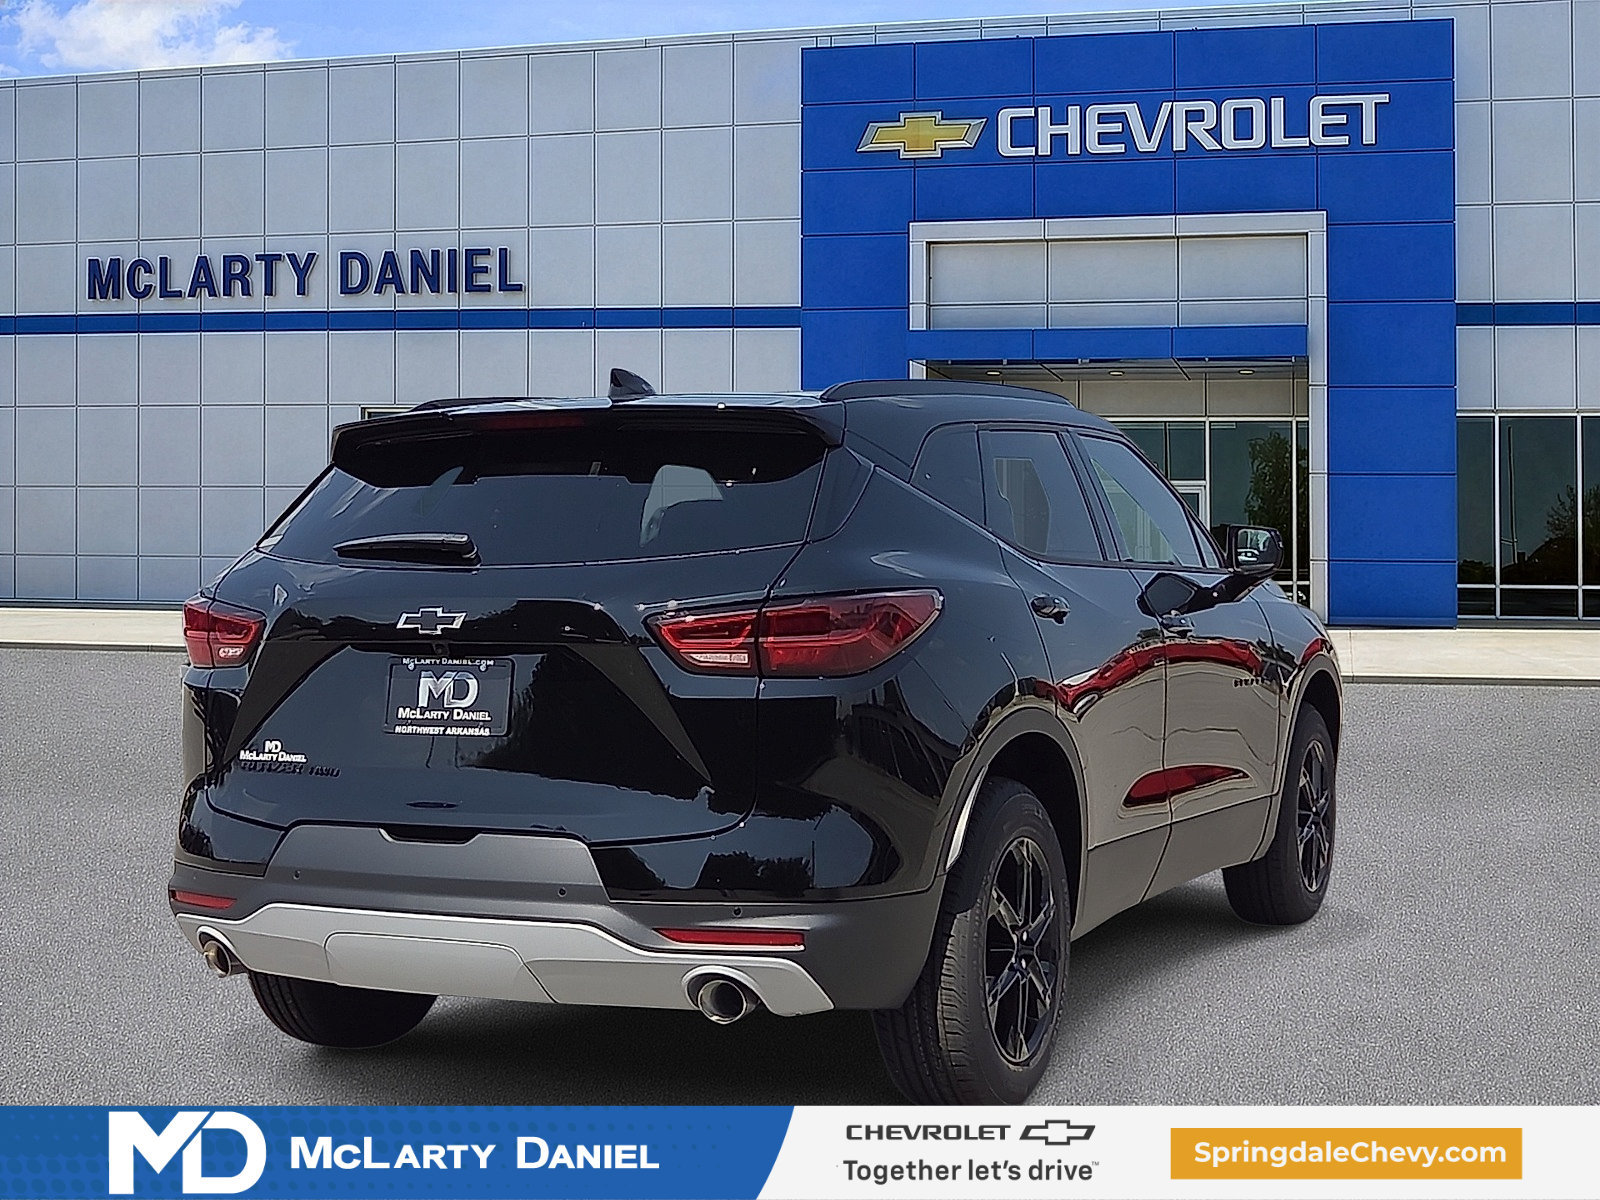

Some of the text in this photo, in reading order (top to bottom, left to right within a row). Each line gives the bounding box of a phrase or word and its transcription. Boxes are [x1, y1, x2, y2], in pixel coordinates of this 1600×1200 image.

[996, 93, 1390, 158] CHEVROLET
[340, 247, 524, 295] DANIEL
[418, 671, 478, 708] MD
[395, 725, 491, 736] NORTHWEST ARKANSAS
[453, 709, 492, 721] DANIEL
